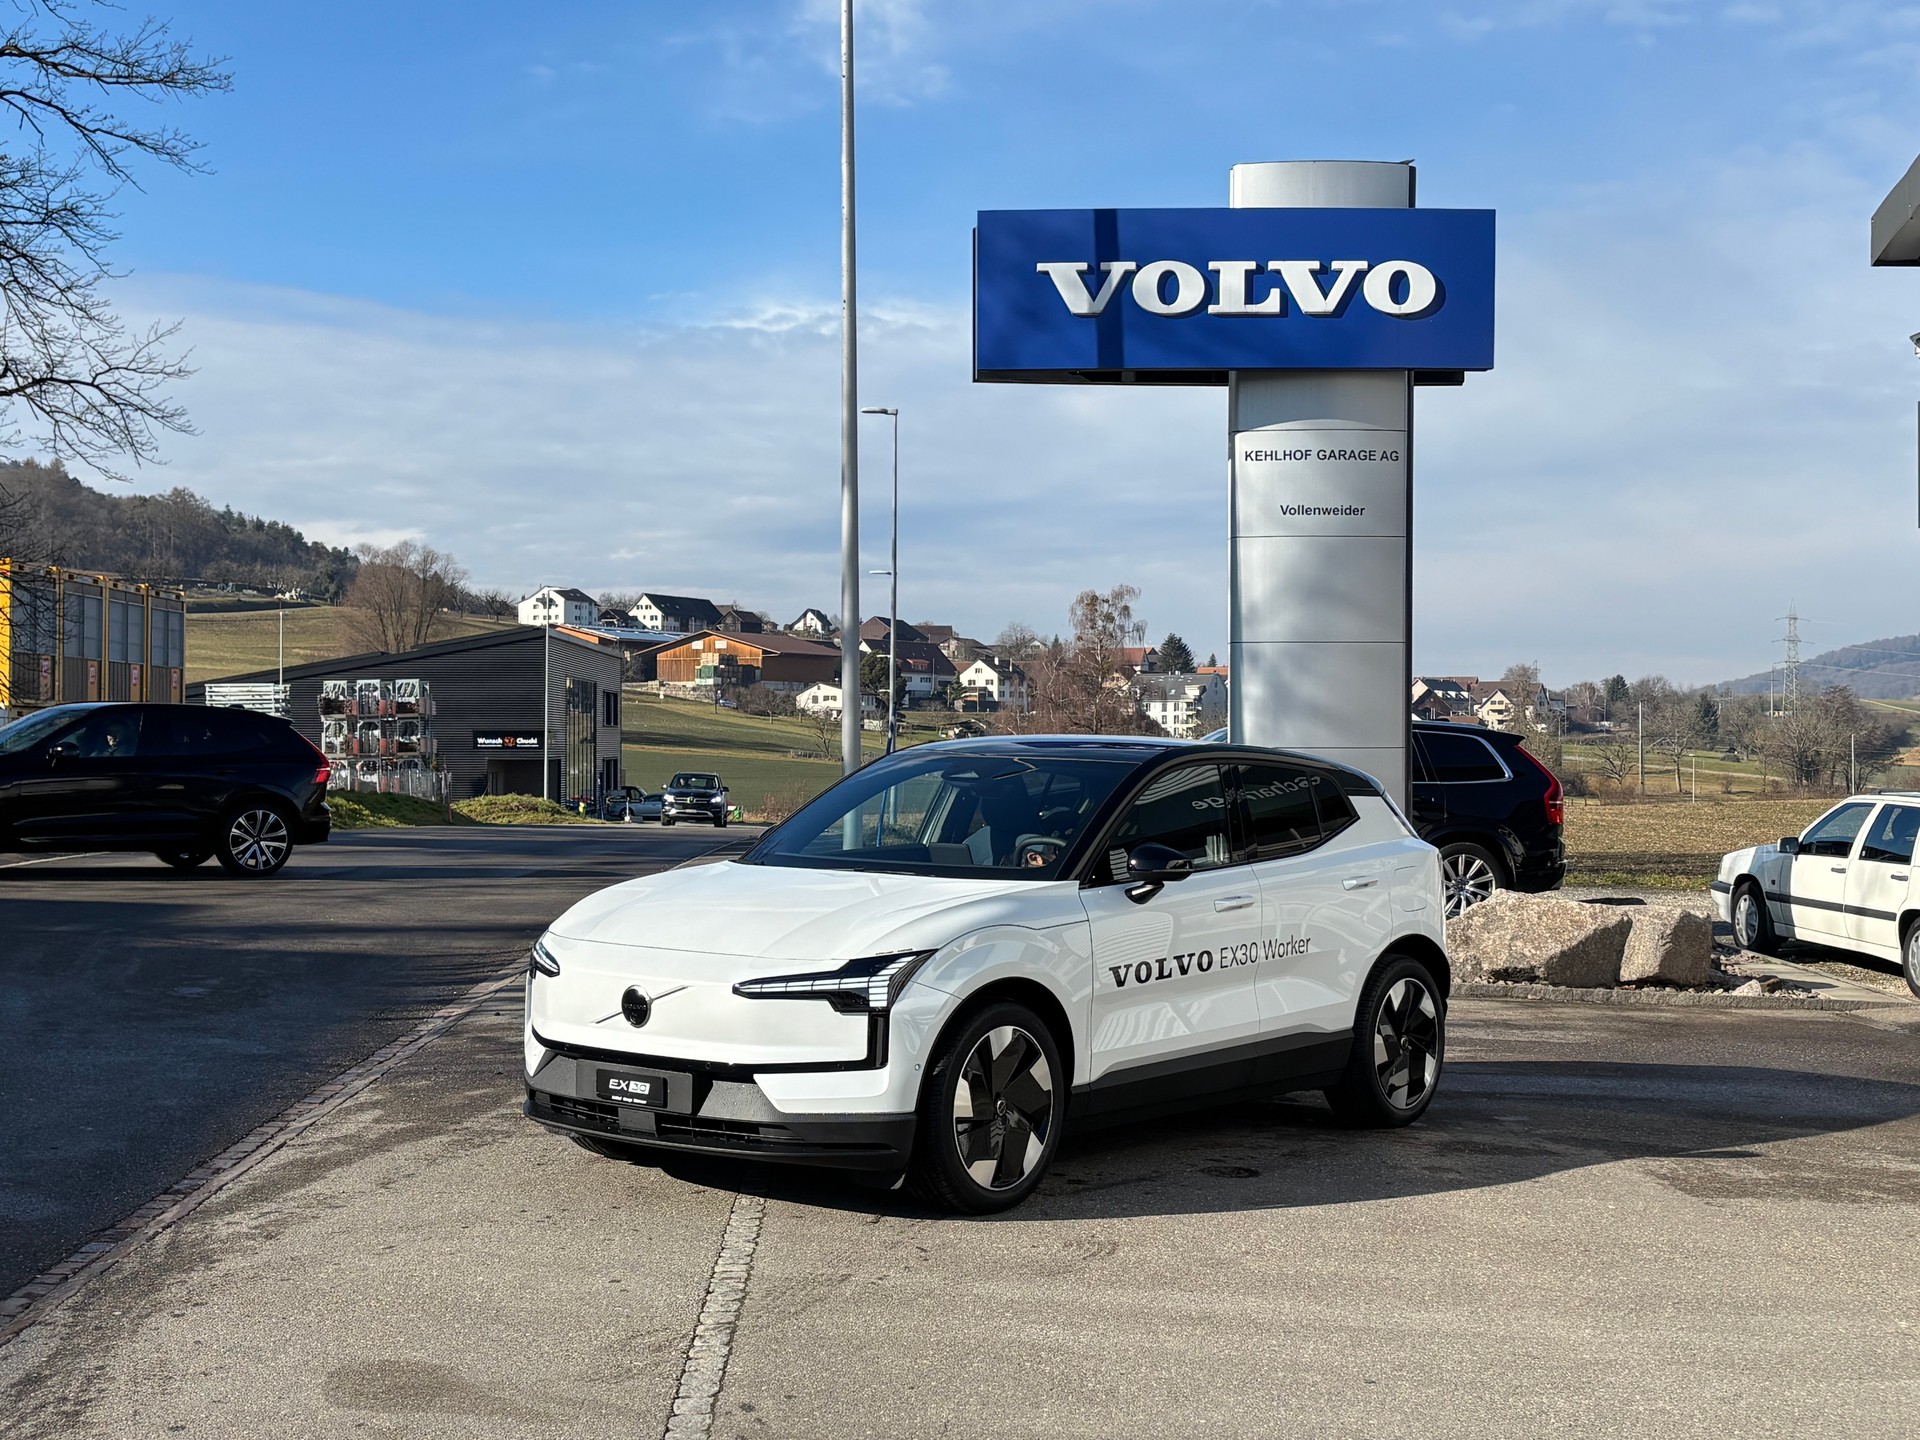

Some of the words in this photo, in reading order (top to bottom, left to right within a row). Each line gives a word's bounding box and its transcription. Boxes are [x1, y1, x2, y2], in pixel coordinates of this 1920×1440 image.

[1036, 260, 1437, 316] VOLVO
[1244, 449, 1313, 462] KEHLHOF
[1316, 449, 1377, 462] GARAGE
[1379, 450, 1400, 462] AG
[1280, 504, 1366, 517] Vollenweider
[1108, 950, 1214, 988] VOLVO
[1219, 941, 1259, 969] EX30
[1262, 934, 1311, 961] Worker
[608, 1078, 651, 1095] EX30
